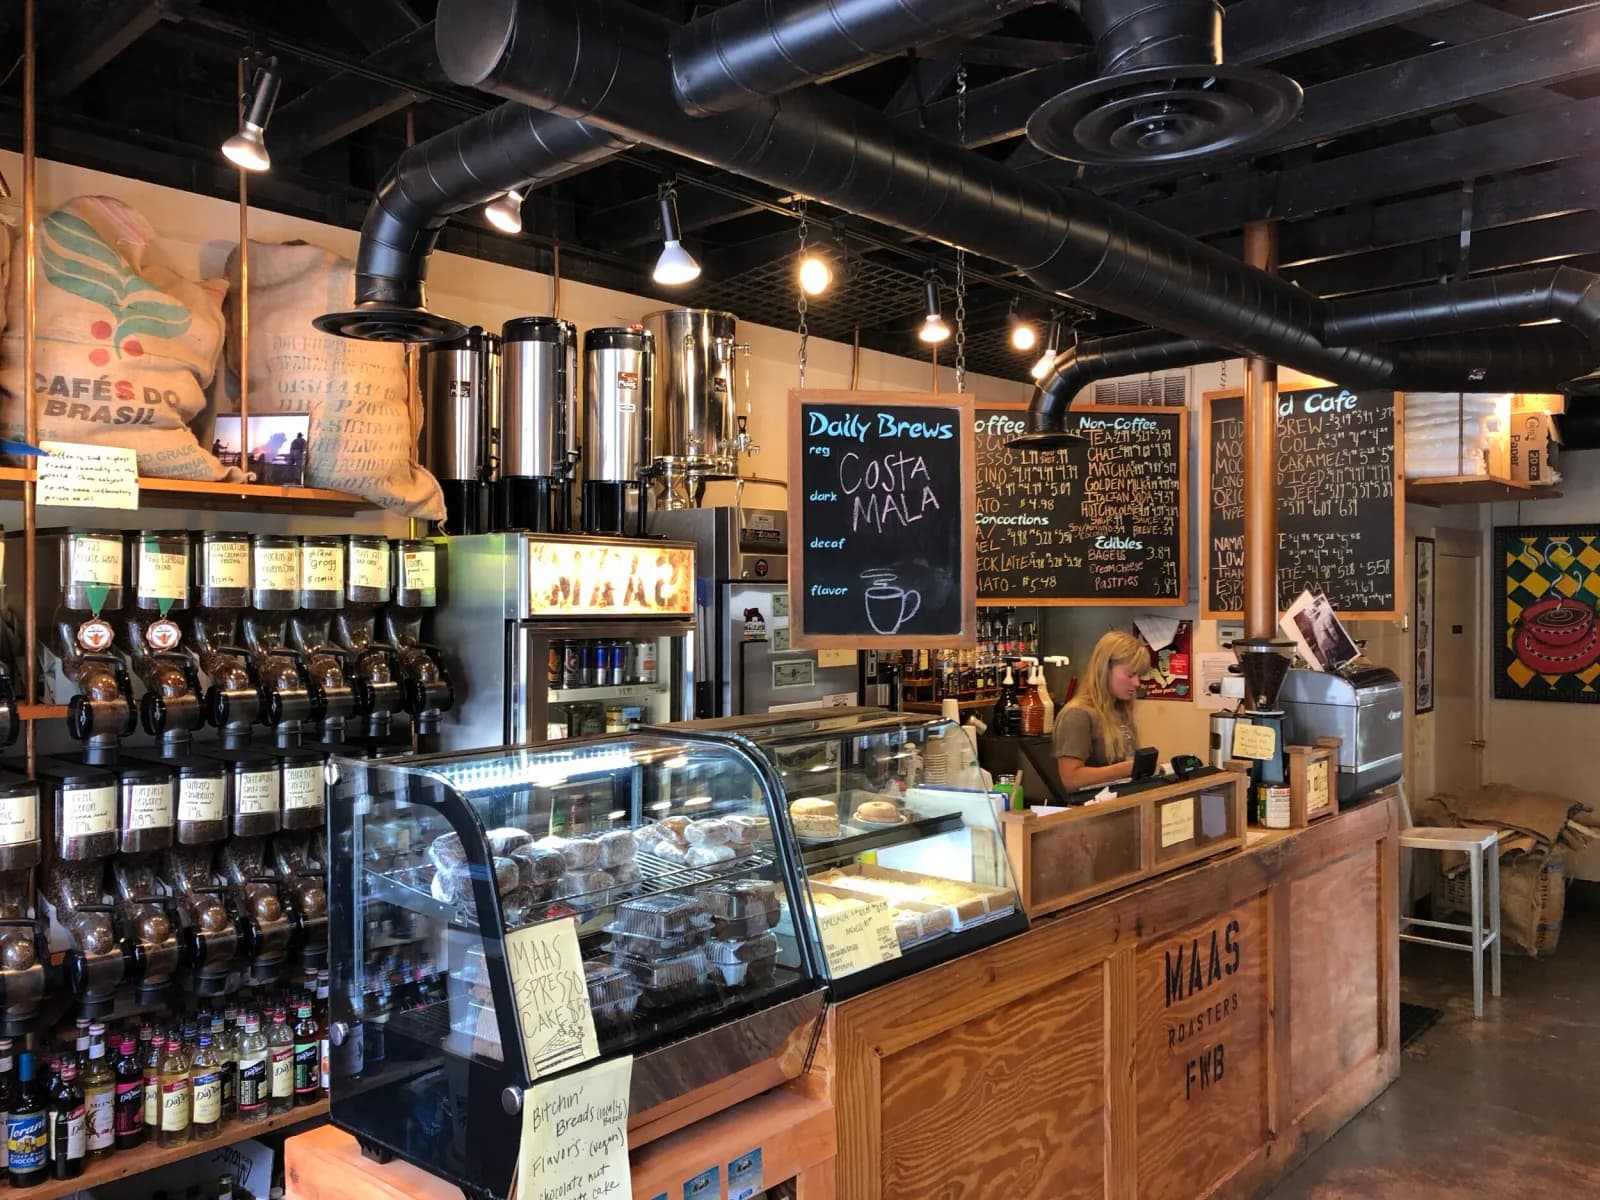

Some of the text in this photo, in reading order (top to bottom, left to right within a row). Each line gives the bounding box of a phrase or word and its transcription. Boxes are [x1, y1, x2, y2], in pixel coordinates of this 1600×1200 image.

[35, 372, 181, 408] CAFÉS DO
[1304, 390, 1358, 413] Cafe
[44, 399, 156, 425] BRASIL
[809, 412, 953, 443] Daily Brews
[974, 415, 1026, 435] offee
[1079, 417, 1157, 431] Non-Coffee
[809, 445, 830, 457] reg
[1280, 435, 1327, 454] COLA
[1511, 435, 1520, 467] Paper
[976, 451, 1013, 466] ESSO
[1529, 452, 1538, 464] 20
[839, 450, 931, 495] COSTA
[976, 466, 1007, 486] CINO
[809, 490, 838, 502] dark
[976, 497, 1000, 513] ATO
[852, 485, 940, 534] MALA
[975, 513, 1050, 526] Concoctions
[809, 538, 847, 549] decaf
[1094, 536, 1144, 550] Edibles
[810, 585, 849, 597] flavor
[512, 934, 562, 978] MAAS
[1164, 919, 1240, 1009] MAAS
[521, 1003, 567, 1039] CAKE
[1168, 993, 1239, 1049] ROASTERS
[1185, 1043, 1225, 1101] FWB
[533, 1086, 584, 1133] Bitchin'
[556, 1103, 595, 1138] Breads
[589, 1127, 624, 1157] (vegan)
[588, 1163, 611, 1182] nut
